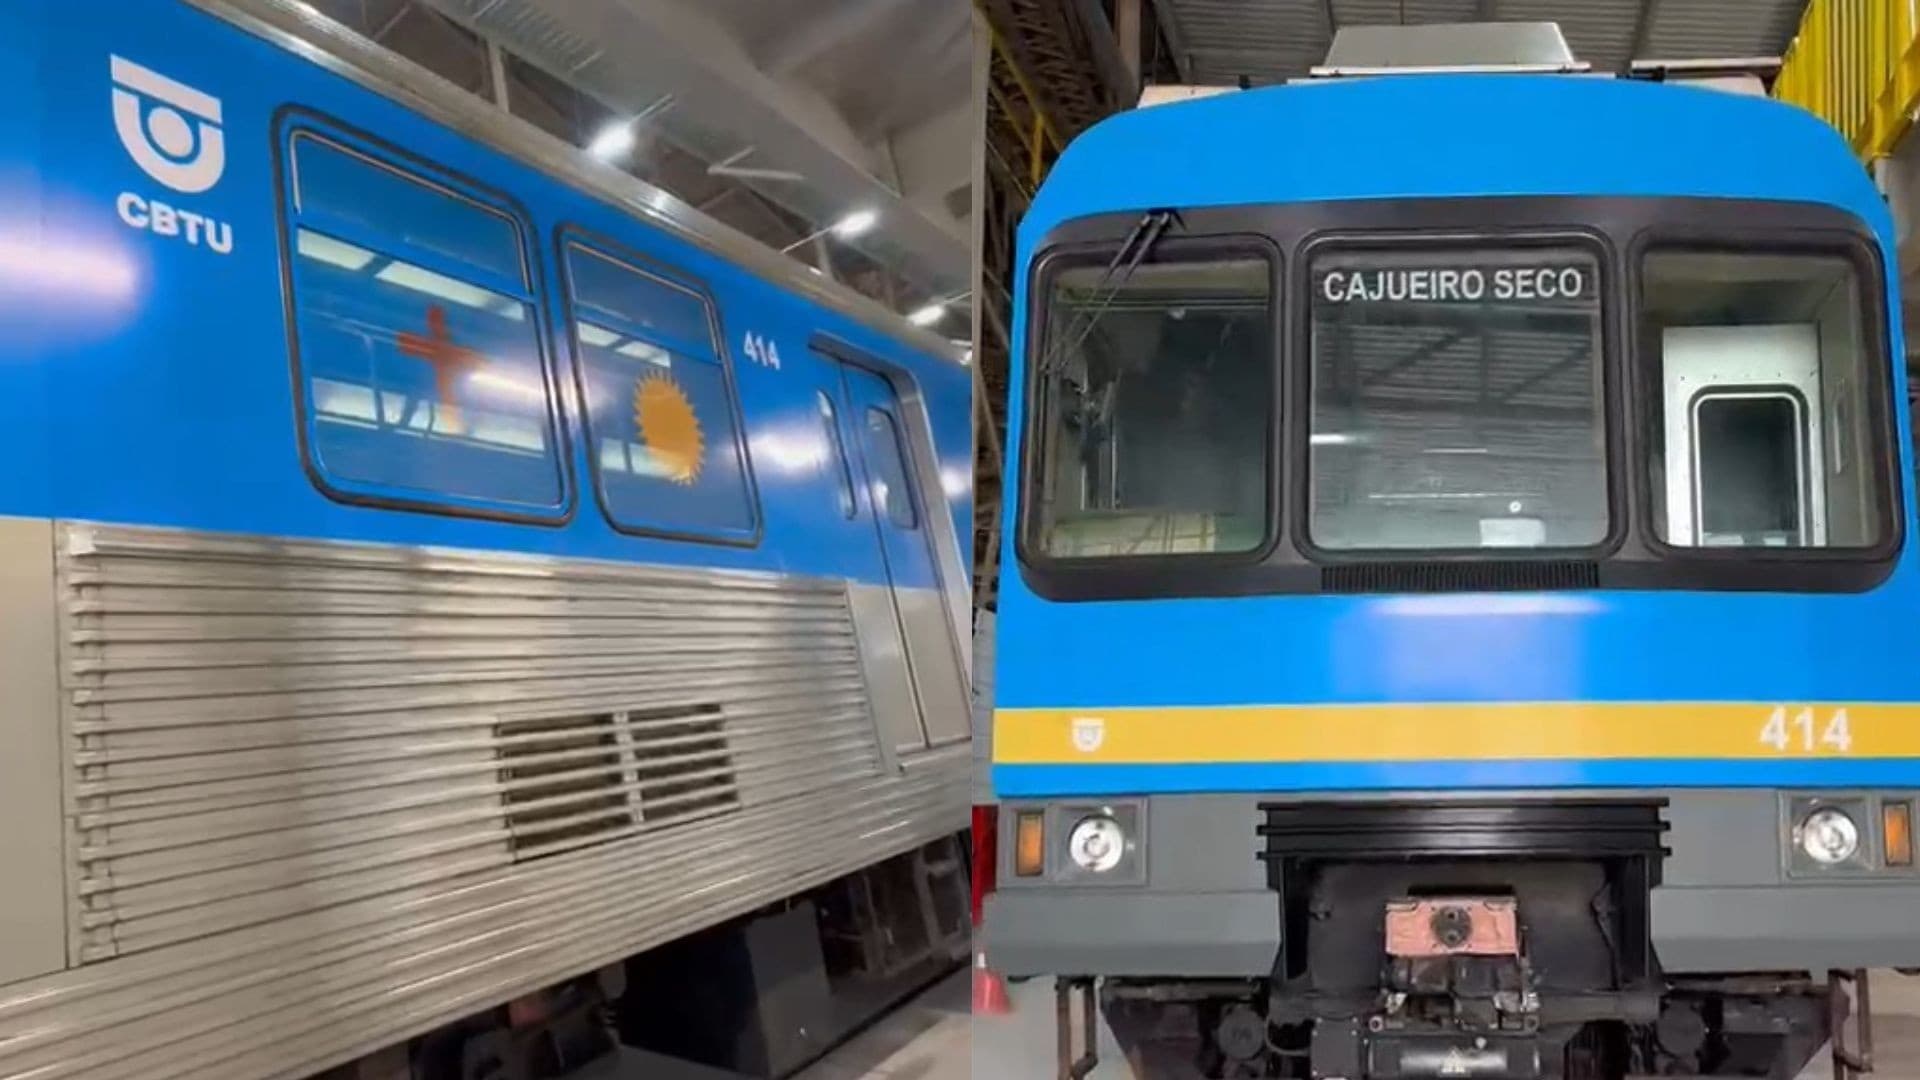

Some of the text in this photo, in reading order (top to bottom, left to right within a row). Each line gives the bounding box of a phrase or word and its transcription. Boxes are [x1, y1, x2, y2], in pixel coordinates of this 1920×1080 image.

[117, 191, 232, 254] CBTU
[1324, 268, 1582, 301] CAJUEIRO SECO
[744, 329, 780, 370] 414
[1759, 705, 1852, 751] 414
